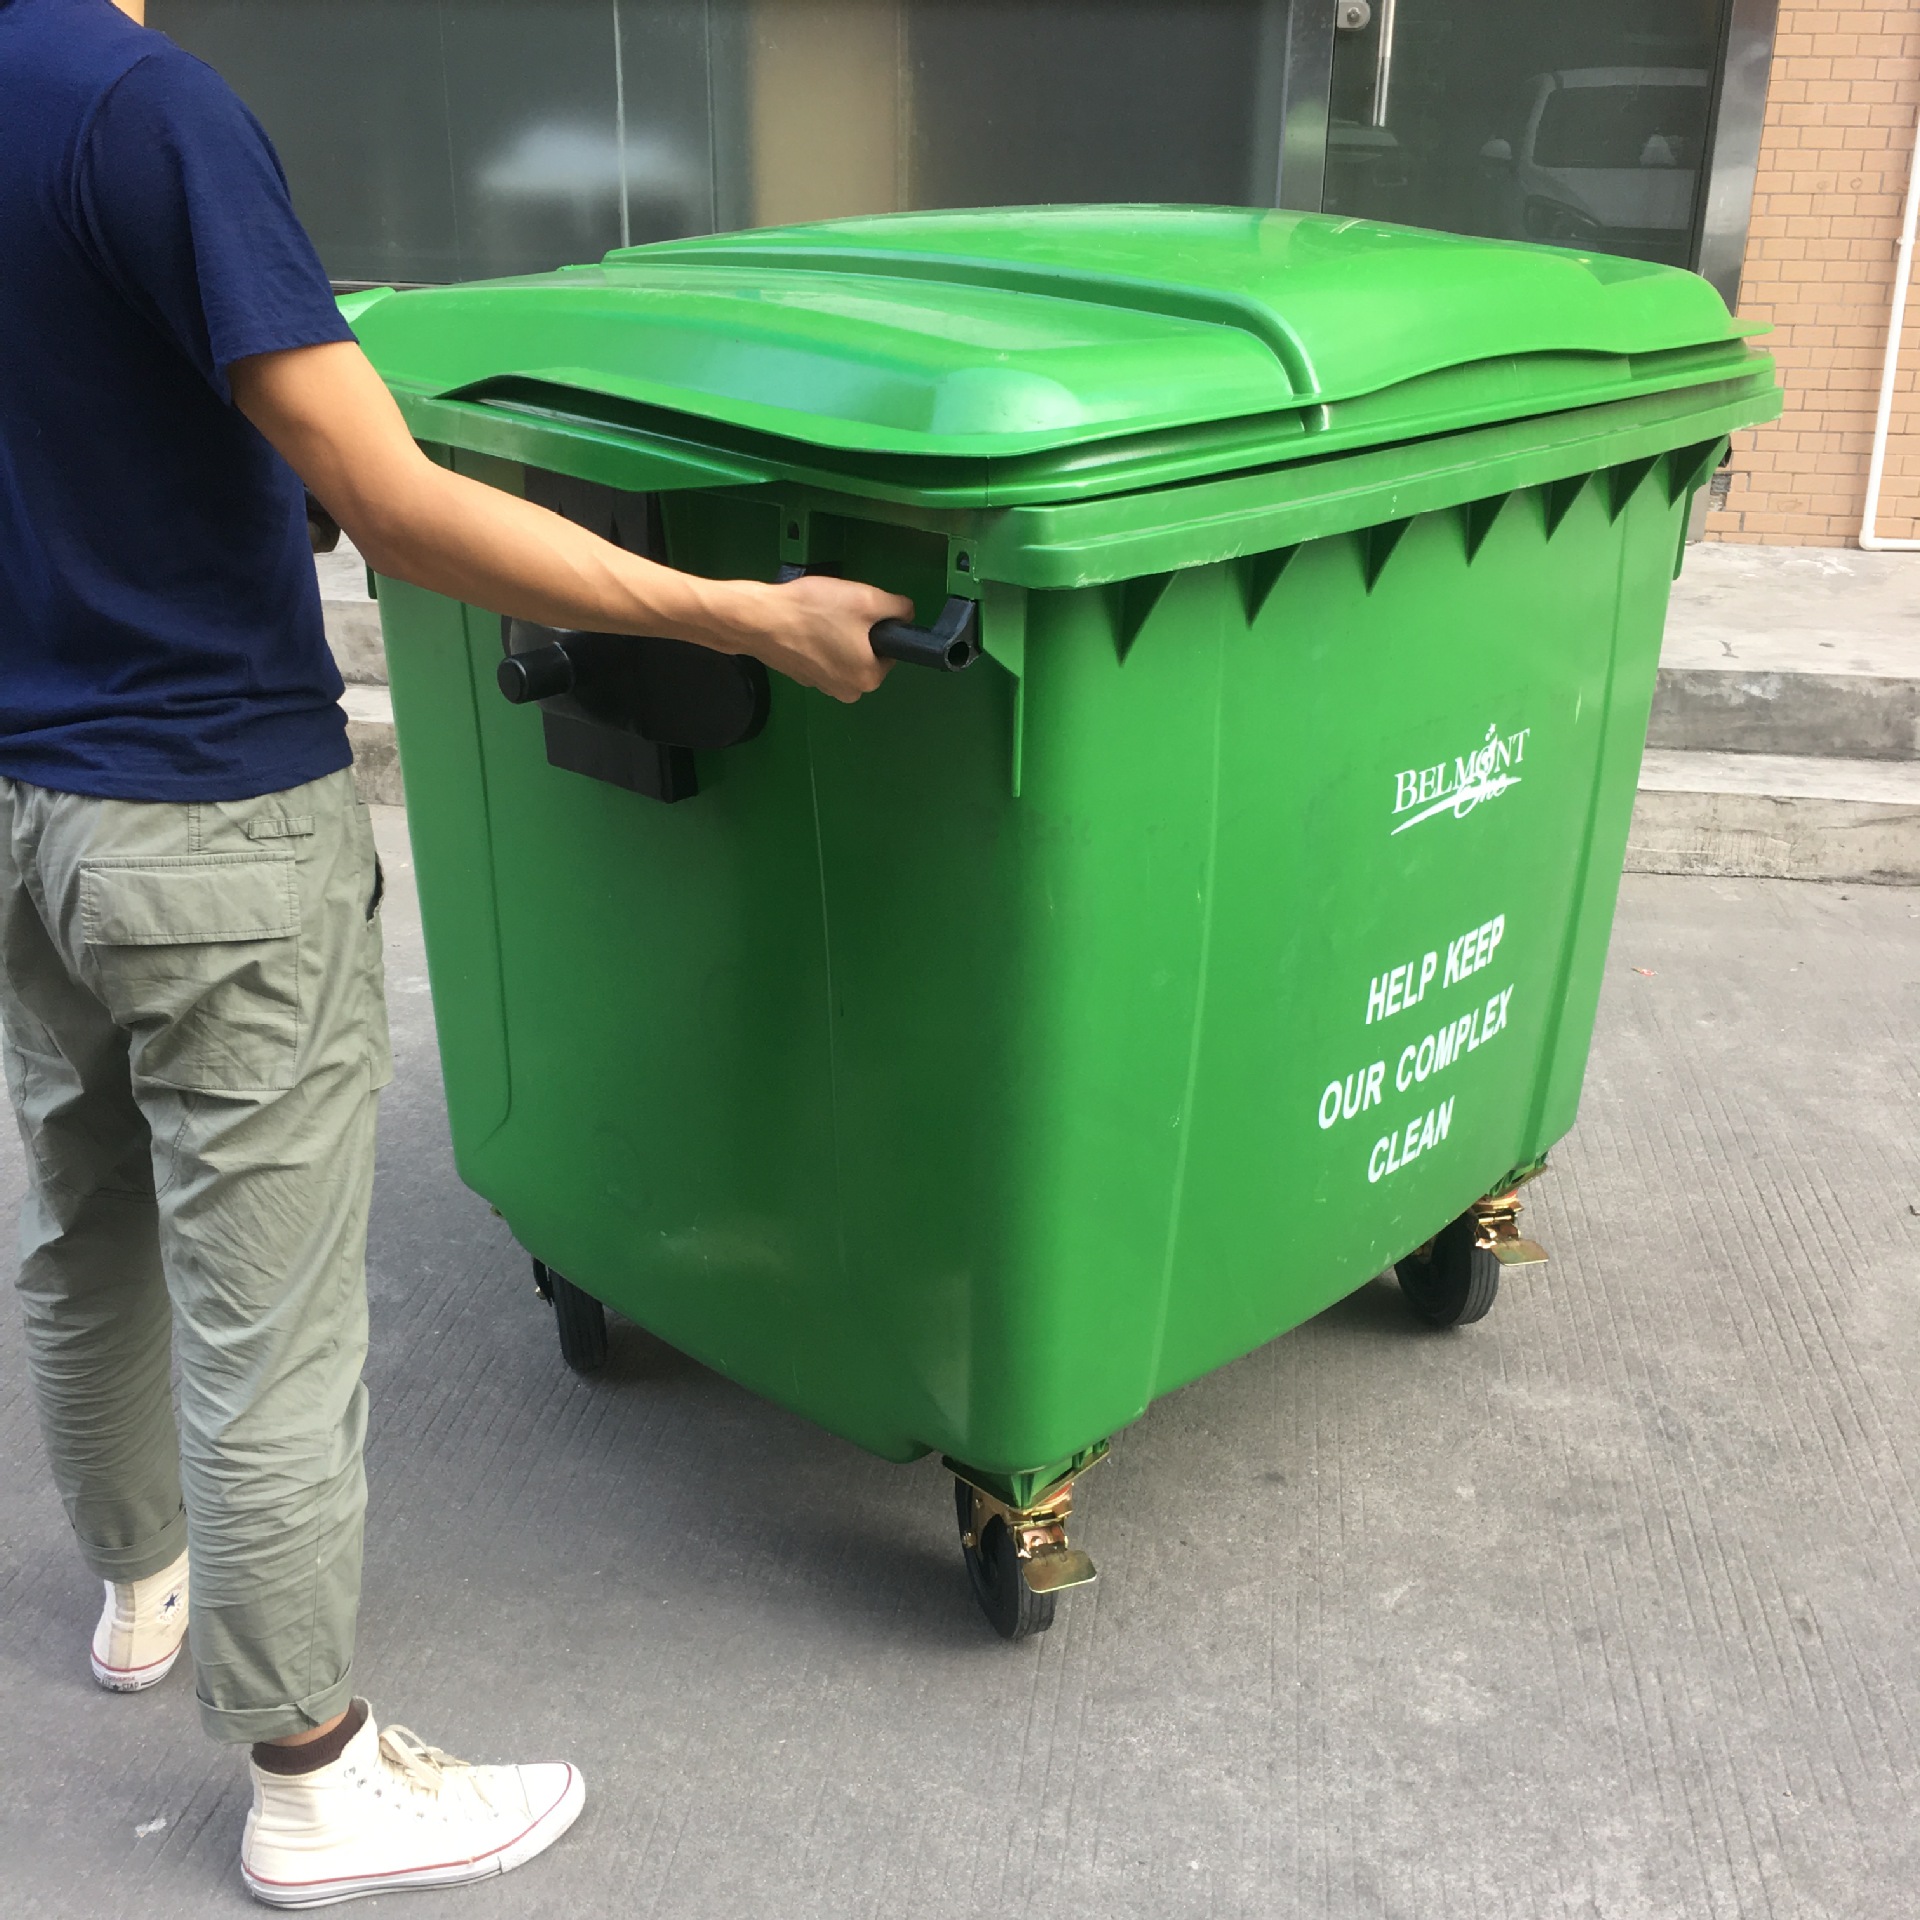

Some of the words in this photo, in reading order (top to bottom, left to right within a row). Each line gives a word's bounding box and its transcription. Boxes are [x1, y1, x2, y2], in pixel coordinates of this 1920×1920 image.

[1391, 727, 1531, 814] BELMONT
[1365, 950, 1438, 1025] HELP
[1443, 913, 1506, 989] KEEP
[1318, 1060, 1386, 1130] OUR
[1395, 983, 1515, 1092] COMPLEX
[1367, 1095, 1455, 1183] CLEAN
